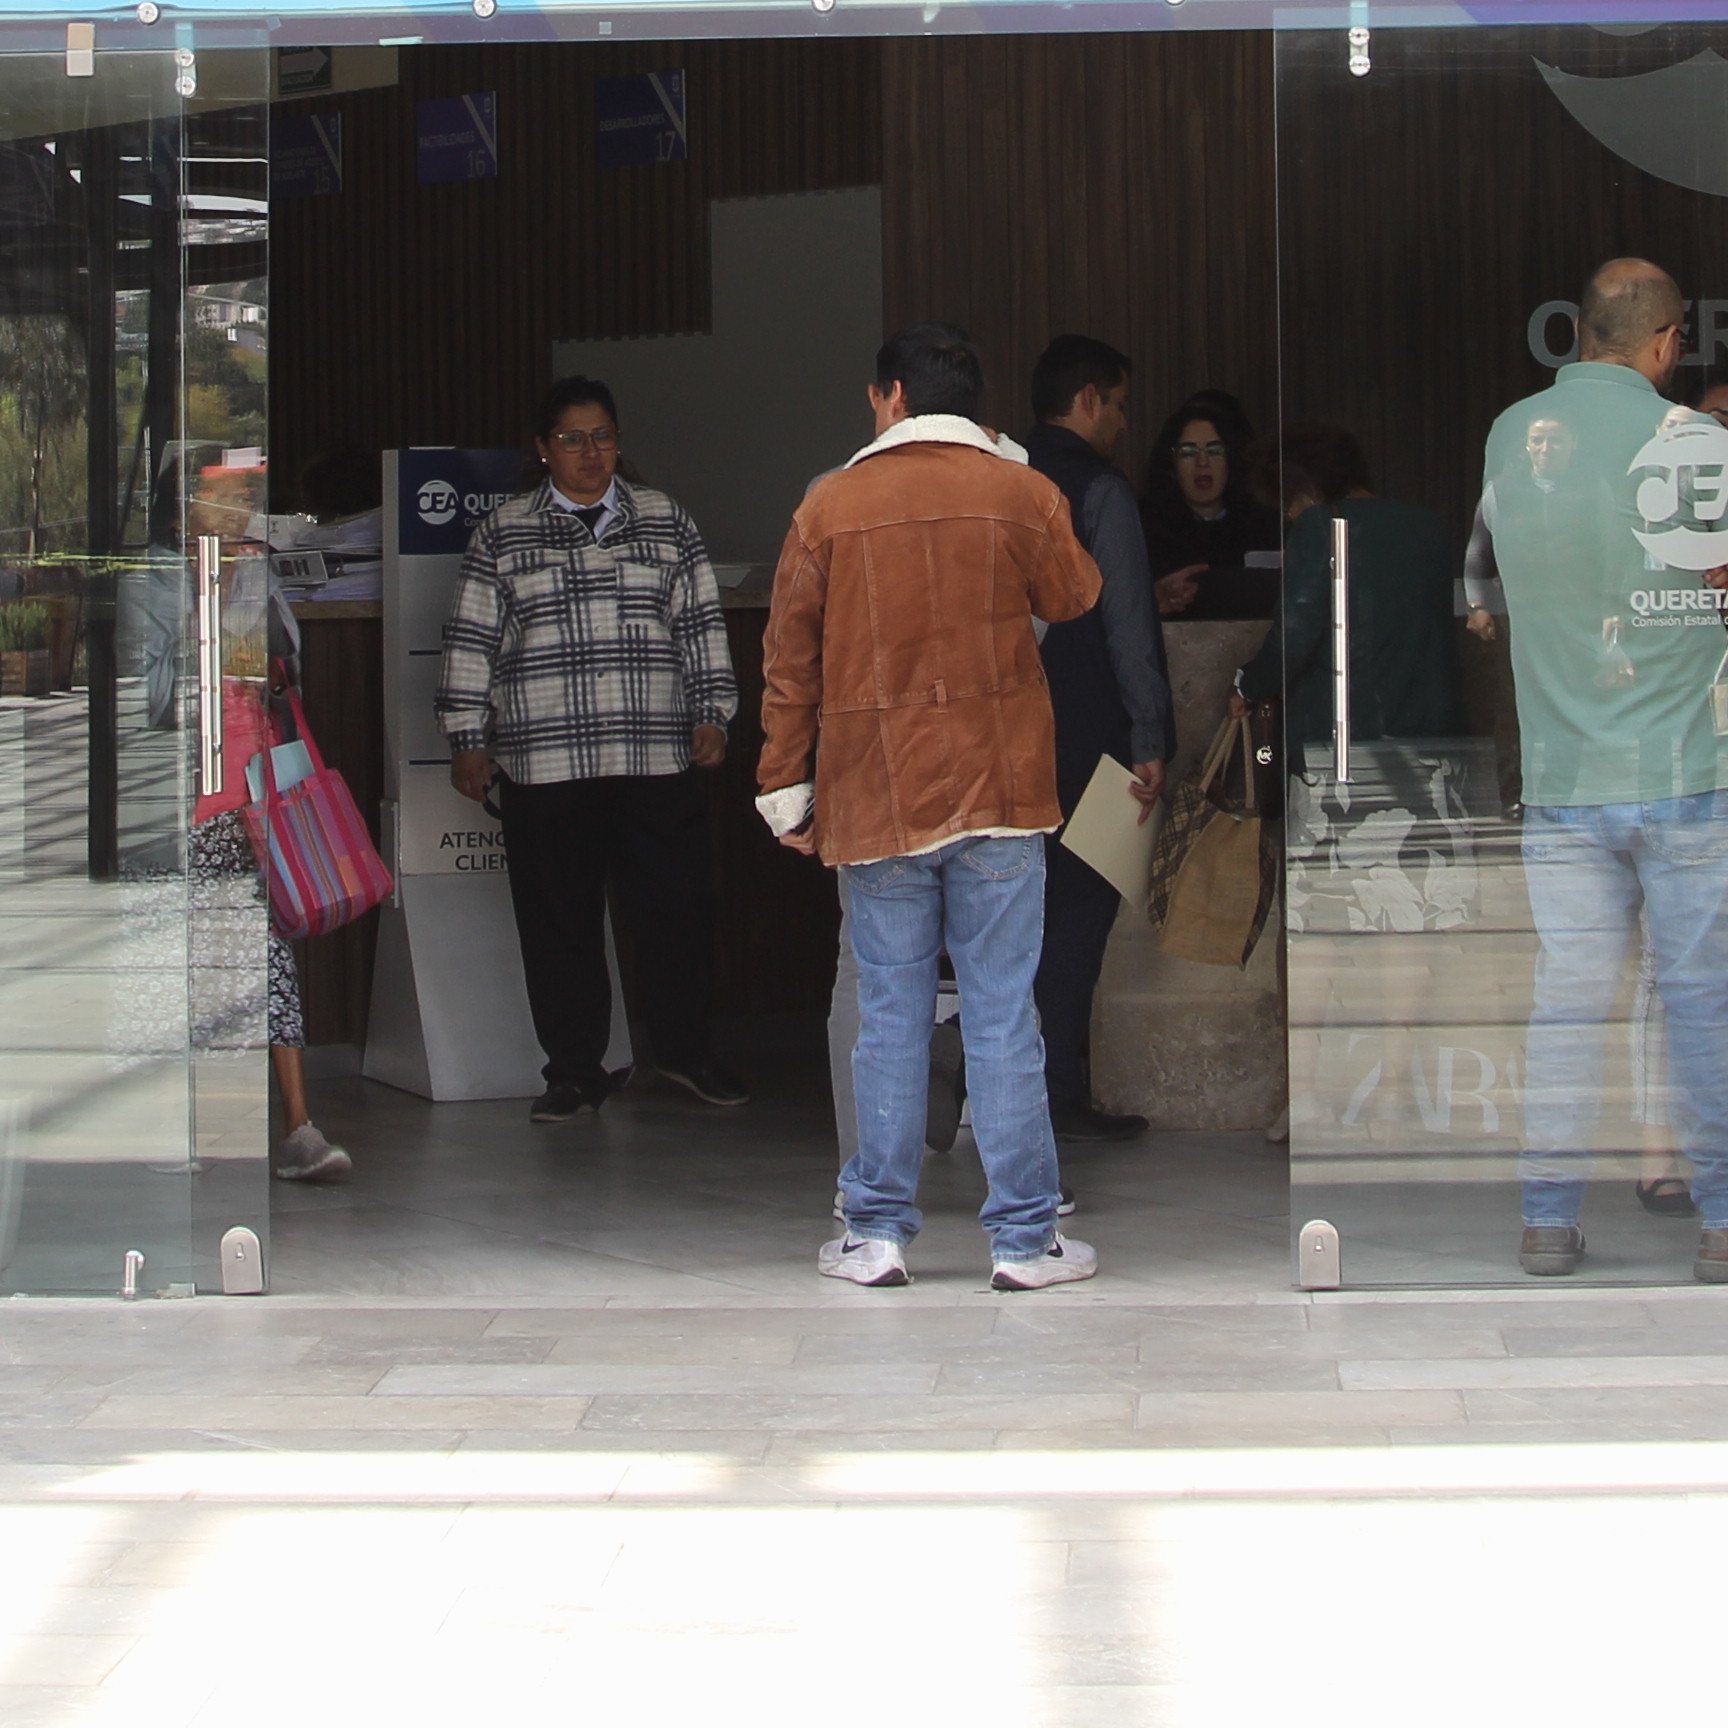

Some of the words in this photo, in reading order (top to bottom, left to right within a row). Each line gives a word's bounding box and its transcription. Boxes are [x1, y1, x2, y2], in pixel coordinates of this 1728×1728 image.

[655, 130, 676, 162] 17
[466, 148, 486, 178] 16
[1632, 615, 1680, 627] Comisión
[1684, 615, 1721, 626] Estatal
